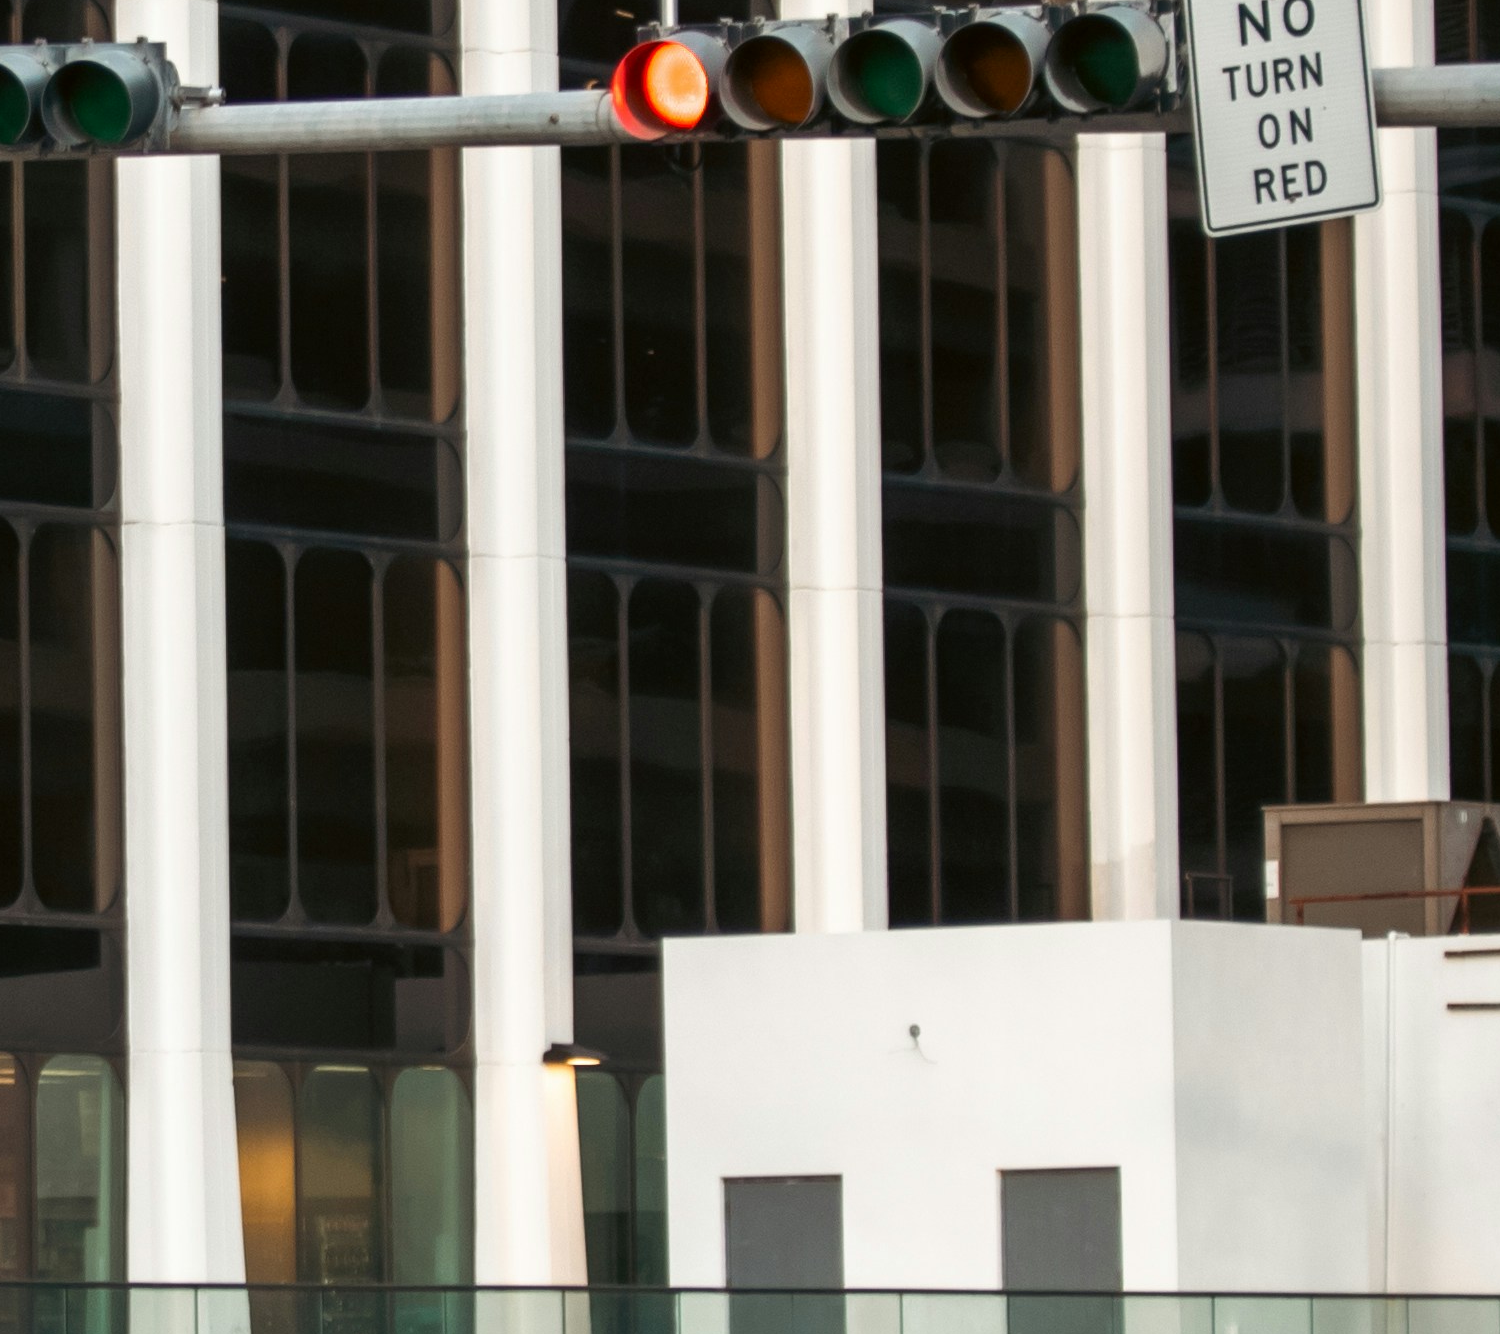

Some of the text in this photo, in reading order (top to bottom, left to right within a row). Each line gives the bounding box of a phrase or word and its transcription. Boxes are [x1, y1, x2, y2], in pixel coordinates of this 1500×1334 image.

[1222, 52, 1323, 102] TURN
[1258, 107, 1312, 149] ON
[1254, 160, 1327, 204] RED
